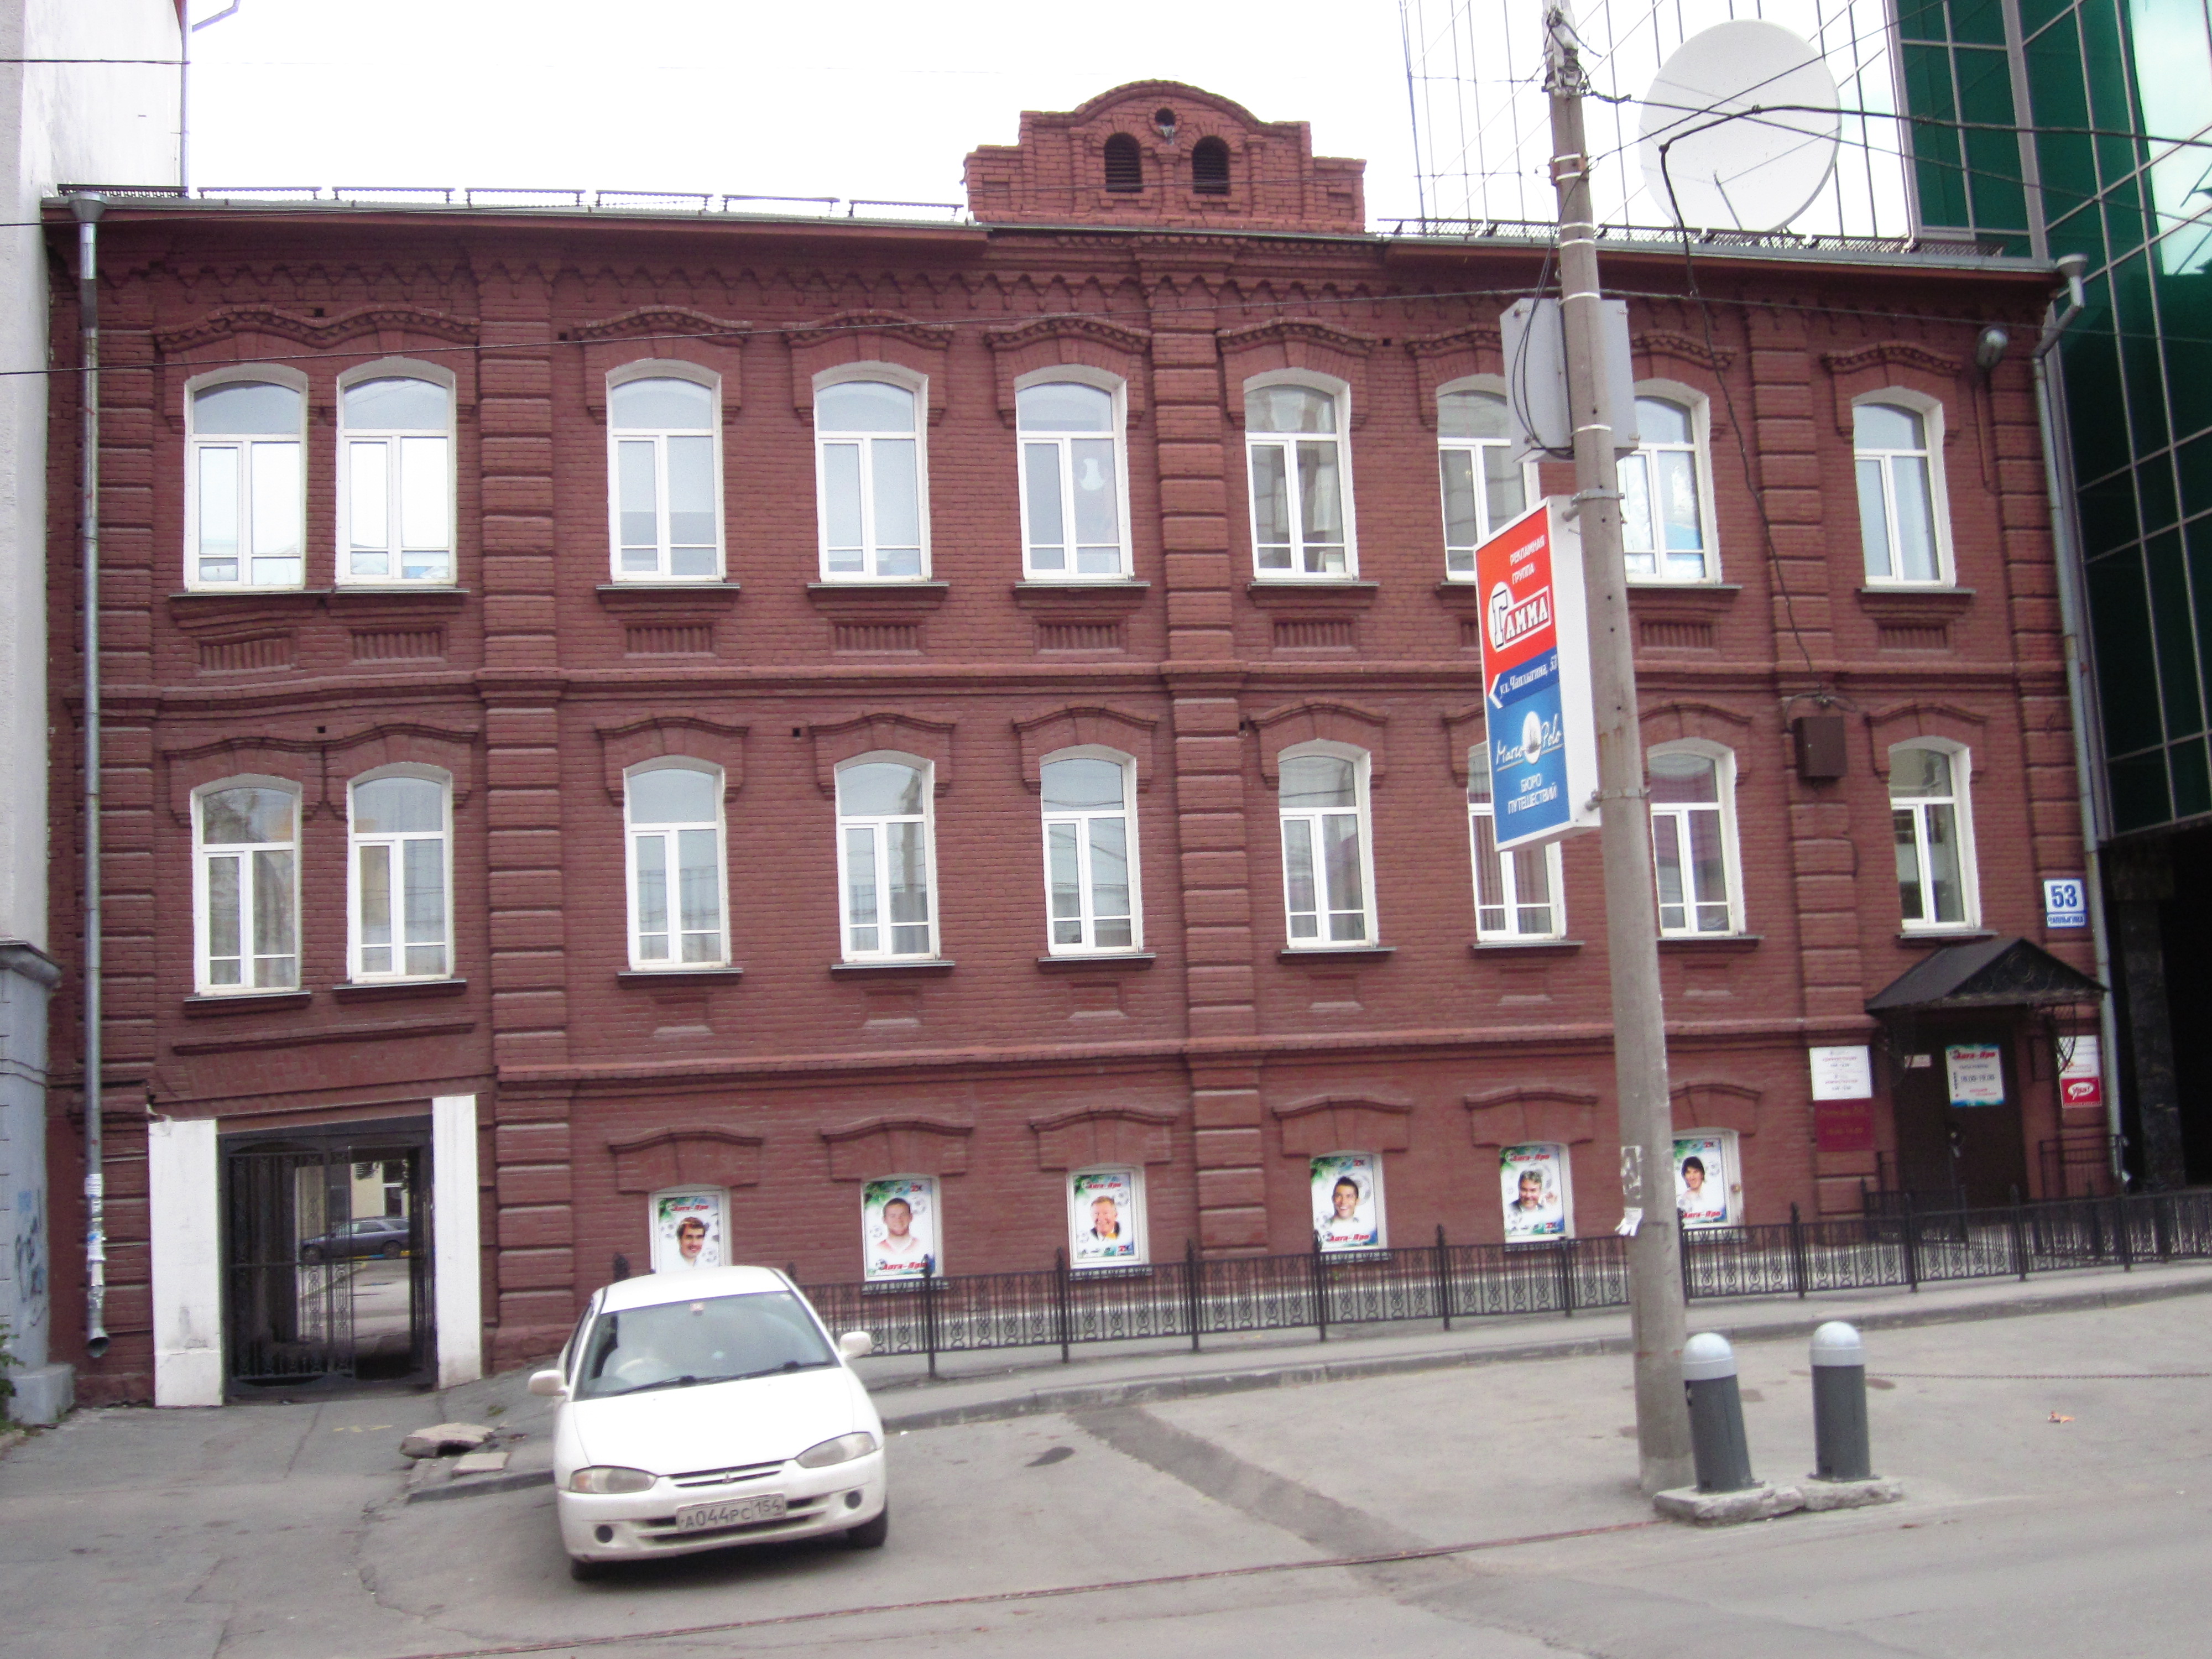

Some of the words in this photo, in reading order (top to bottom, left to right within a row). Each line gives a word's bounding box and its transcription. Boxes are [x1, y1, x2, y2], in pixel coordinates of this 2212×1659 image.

[1510, 535, 1545, 566] РЕКЛАМНАЯ
[1512, 561, 1536, 585] ГРУППА
[1496, 740, 1526, 765] Marco
[1541, 713, 1562, 748] Polo
[1521, 773, 1542, 793] БЮРО
[1508, 782, 1558, 815] ПУТЕШЕСТВИЙ
[2051, 885, 2077, 907] 53
[755, 1499, 781, 1514] 154
